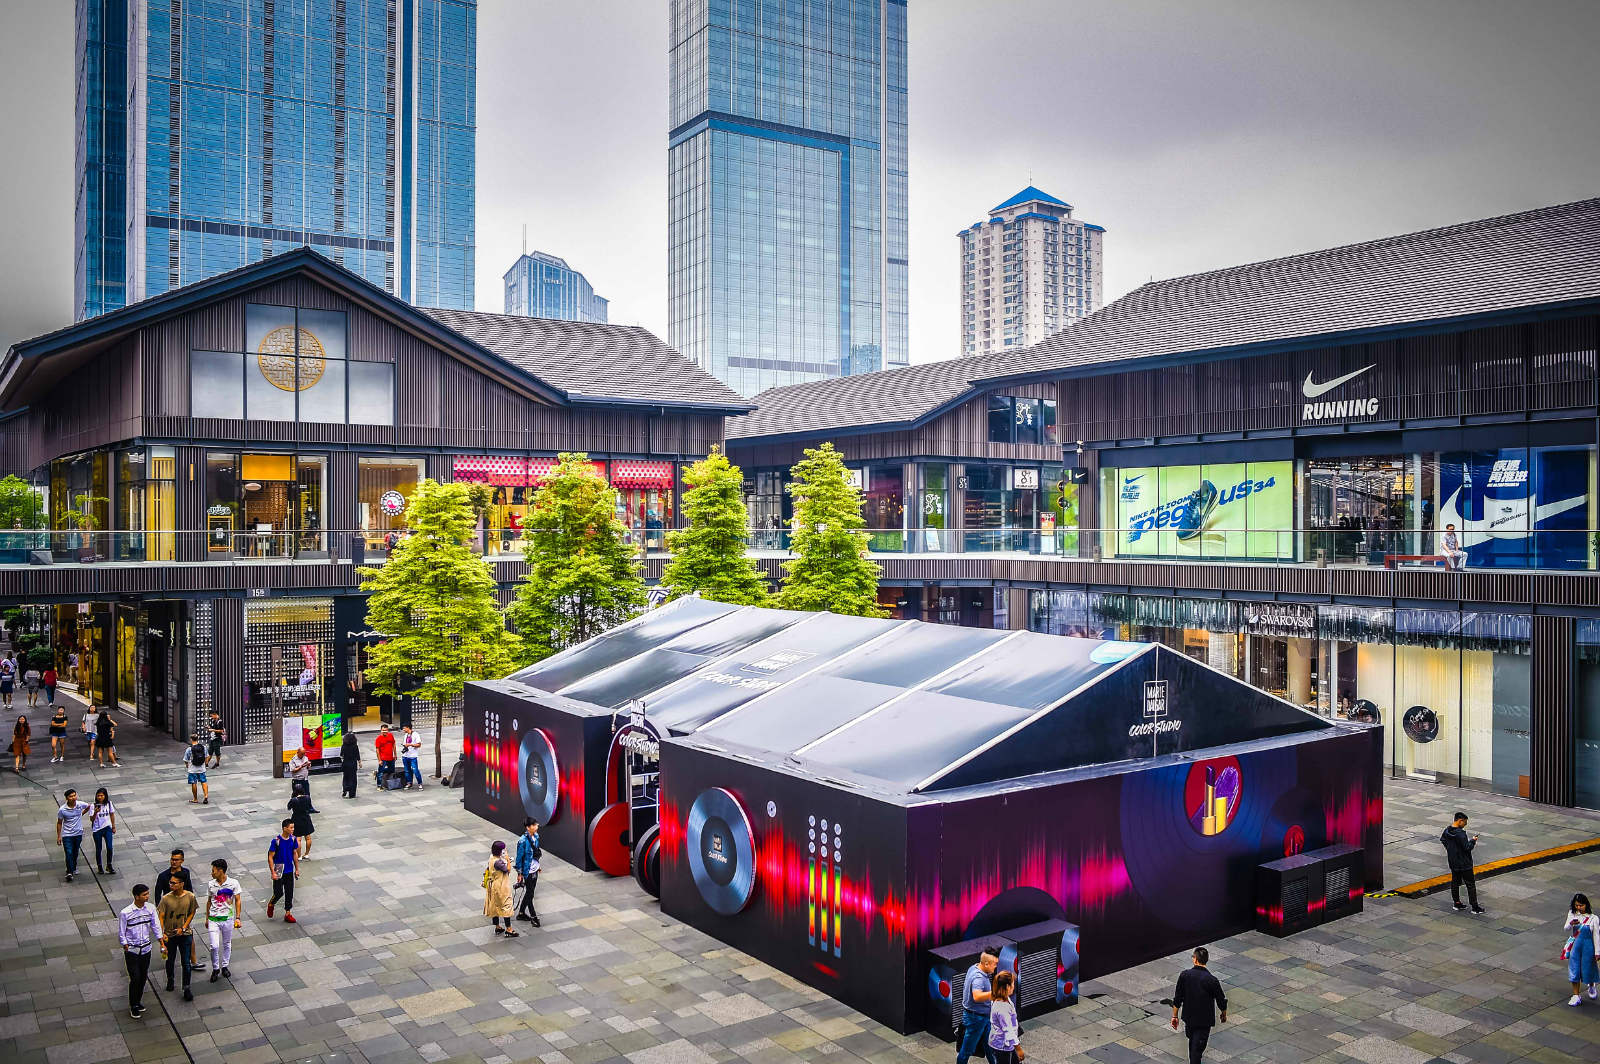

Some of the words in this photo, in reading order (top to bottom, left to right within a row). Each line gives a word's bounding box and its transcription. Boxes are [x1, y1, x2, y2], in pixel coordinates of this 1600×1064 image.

[1302, 398, 1379, 420] RUNNING
[1129, 511, 1149, 523] NIKE
[1260, 614, 1314, 628] SWAROVSKI
[1146, 685, 1166, 699] MARIE
[1128, 722, 1154, 737] COLOR
[1155, 719, 1182, 735] STUDIO
